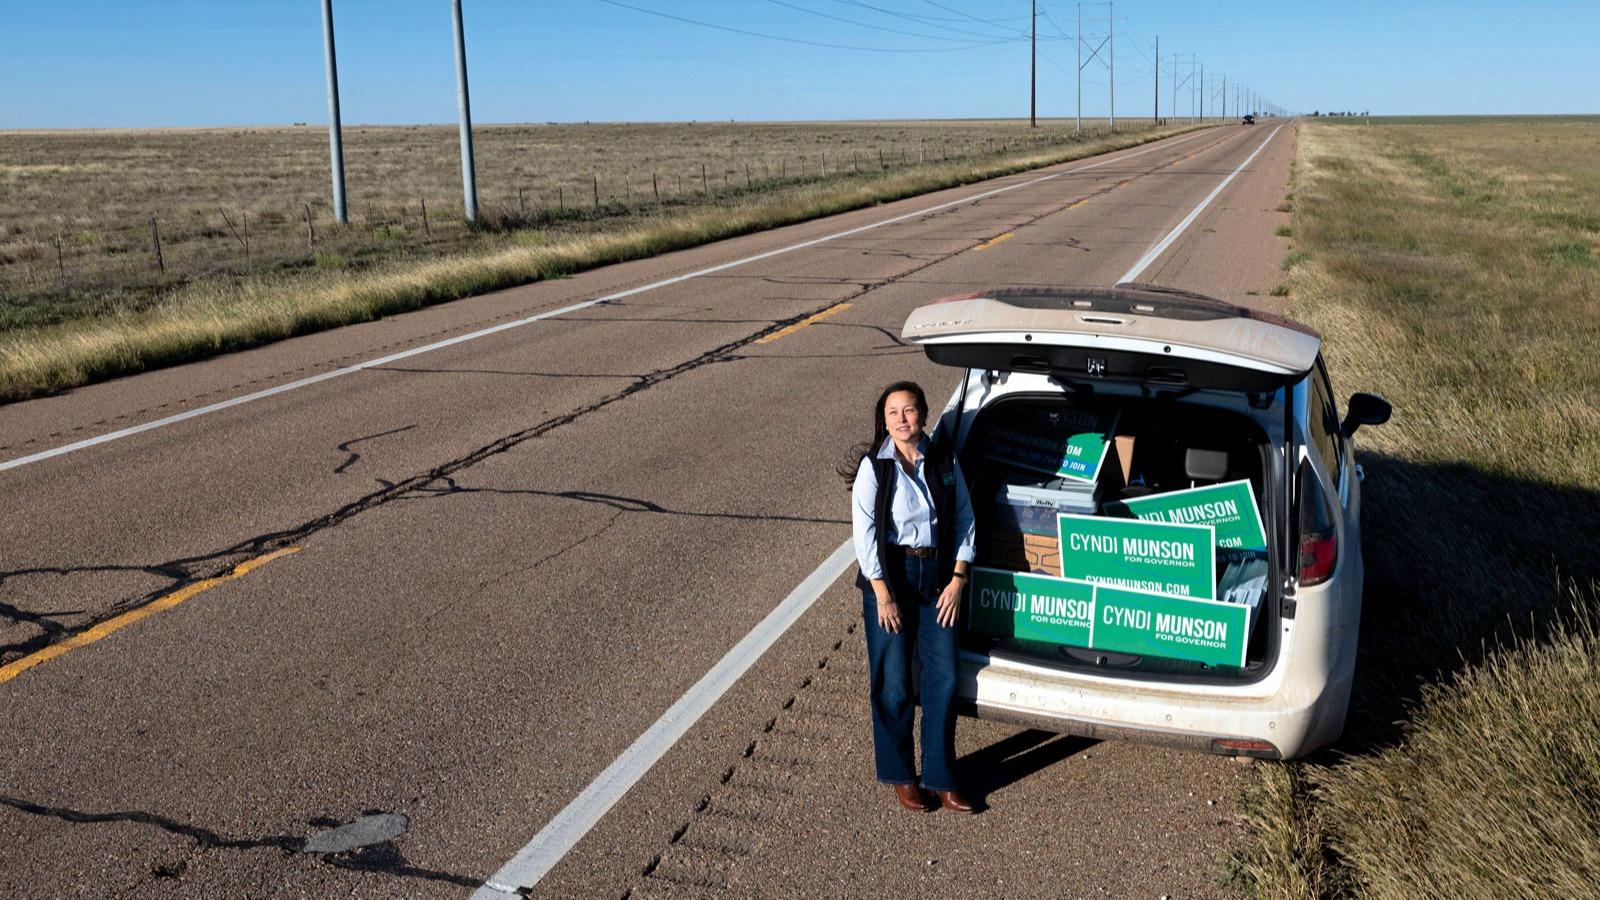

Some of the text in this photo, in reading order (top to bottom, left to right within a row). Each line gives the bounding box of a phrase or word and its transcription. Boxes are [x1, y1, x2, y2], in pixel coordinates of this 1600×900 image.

[1069, 461, 1086, 472] JOIN
[1168, 499, 1238, 524] MUNSON
[1070, 533, 1195, 561] CYNDI MUNSON
[1124, 556, 1196, 568] FOR GOVERNOR
[980, 588, 1026, 613] CYNDI
[1031, 615, 1049, 624] FOR
[1103, 605, 1228, 641] CYNDI MUNSON
[1156, 633, 1227, 649] FOR GOVERNOR
